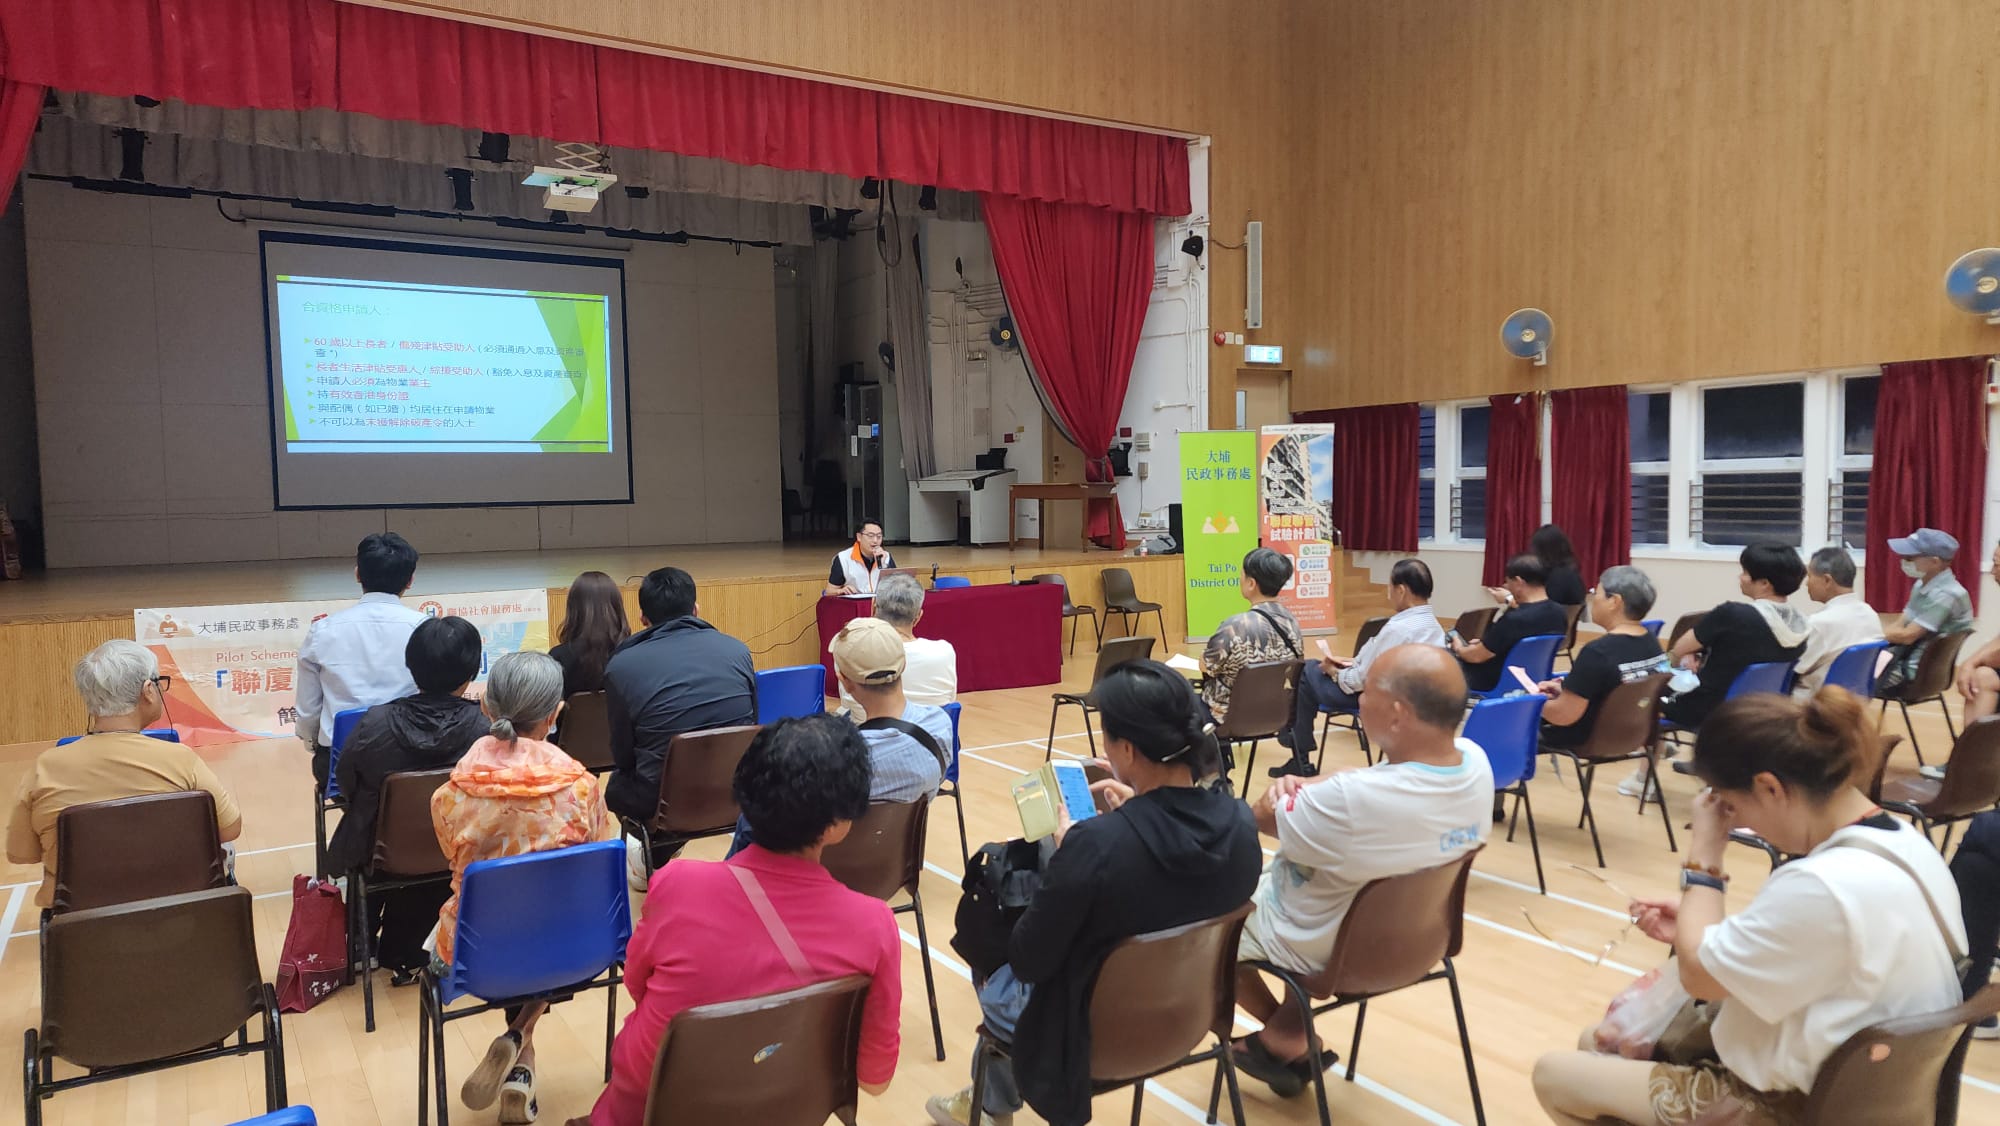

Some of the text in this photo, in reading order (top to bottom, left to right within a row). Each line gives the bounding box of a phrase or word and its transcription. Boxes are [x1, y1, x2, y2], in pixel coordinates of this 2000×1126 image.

[314, 338, 327, 346] 60
[1207, 449, 1231, 464] 大埔
[1186, 466, 1252, 481] 民政事務處
[1208, 563, 1237, 573] Tai Po
[1190, 578, 1225, 588] District
[198, 617, 300, 635] 大埔民政事務處
[216, 648, 298, 663] Pilot Scheme
